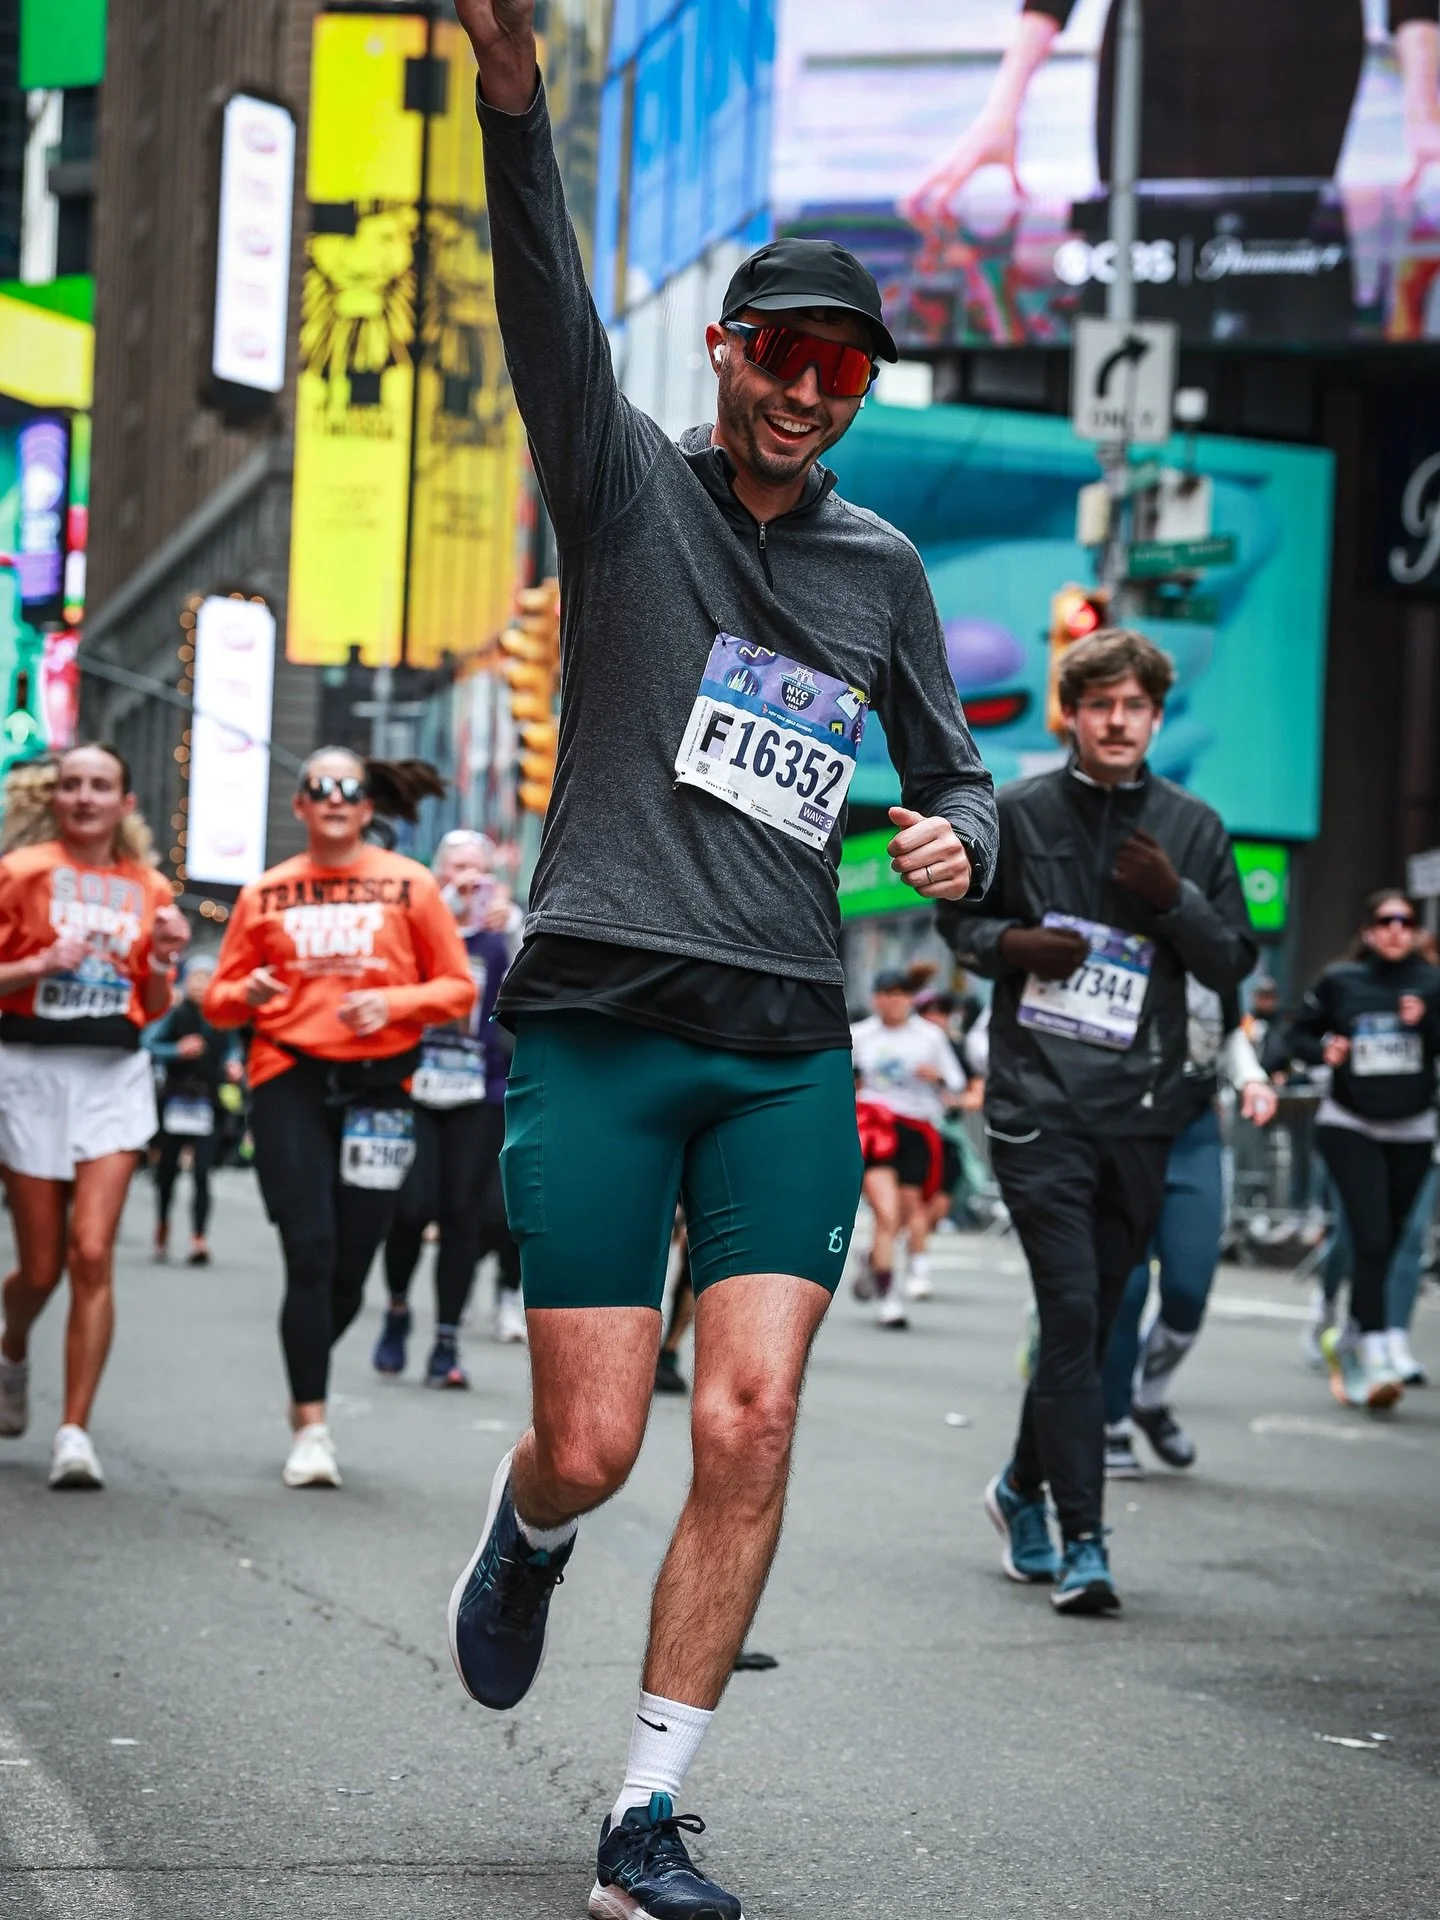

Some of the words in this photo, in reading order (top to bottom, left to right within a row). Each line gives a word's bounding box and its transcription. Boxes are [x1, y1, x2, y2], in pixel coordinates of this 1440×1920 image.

[785, 693, 805, 706] HALF
[786, 684, 809, 701] NYC
[803, 806, 825, 826] WAVE
[824, 819, 833, 829] 3
[260, 877, 412, 915] FRANCESCA
[294, 926, 375, 958] TEAM
[1058, 966, 1132, 1003] 7344
